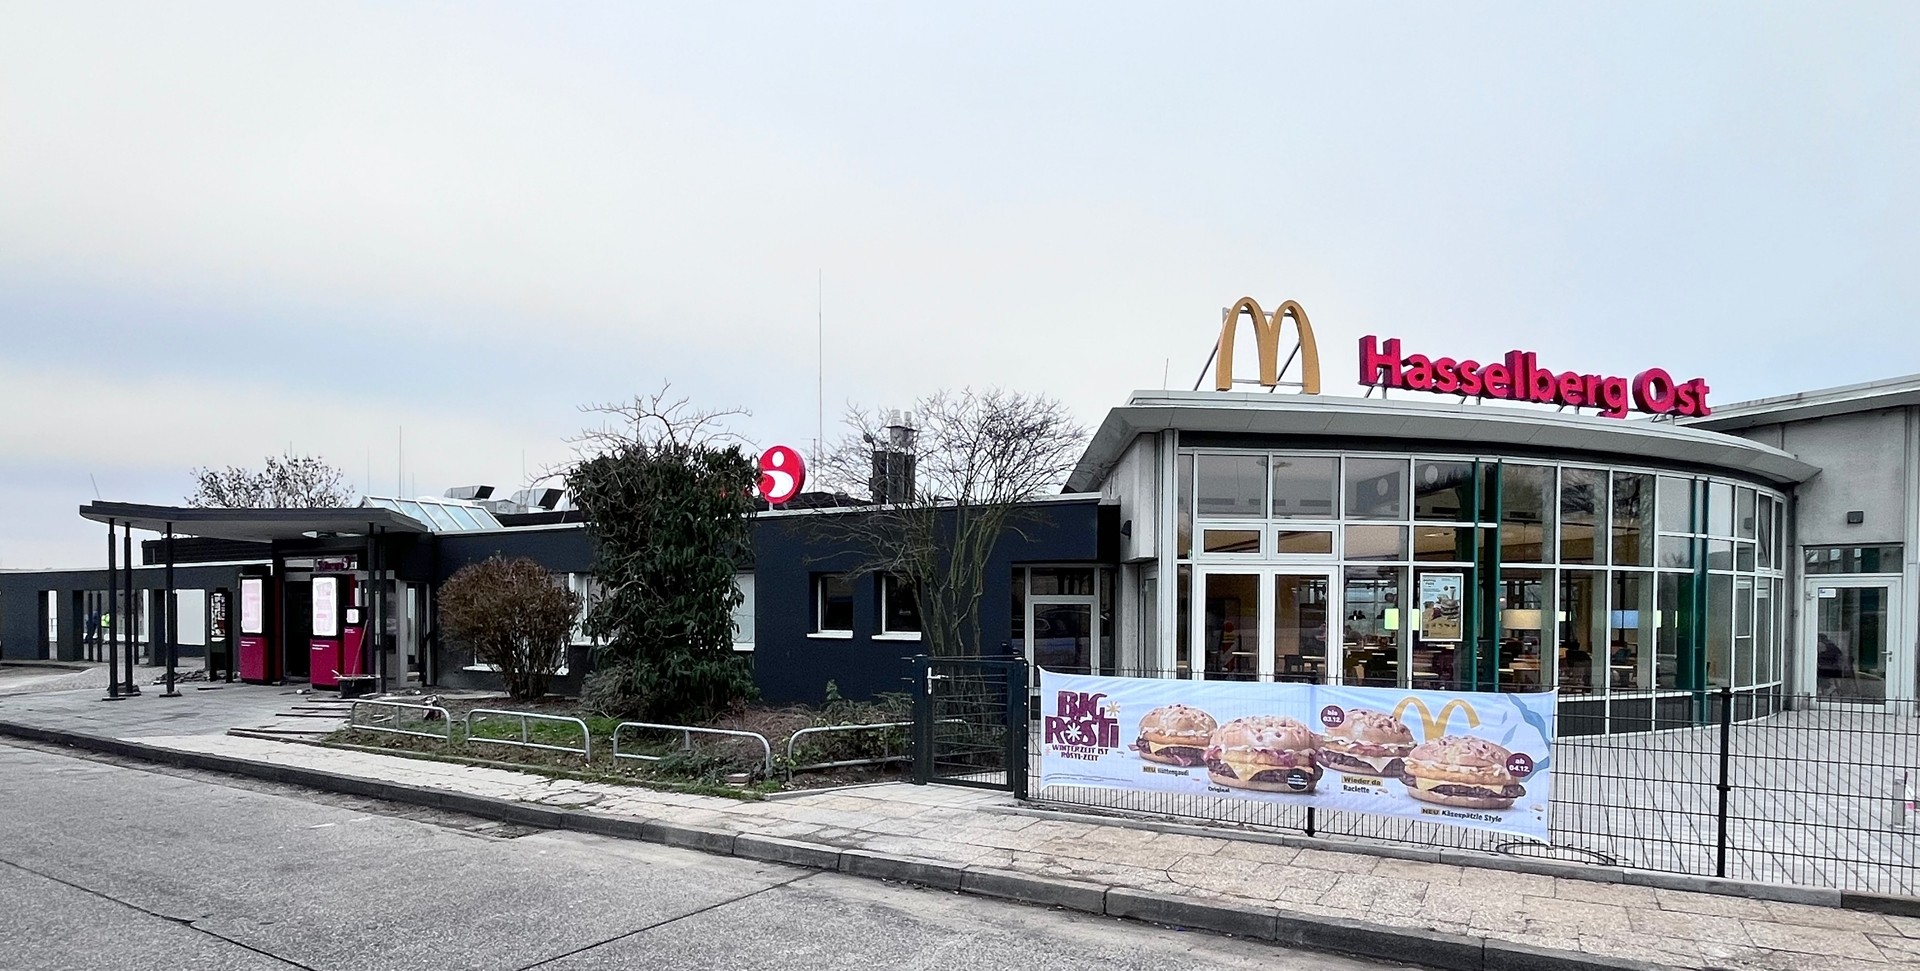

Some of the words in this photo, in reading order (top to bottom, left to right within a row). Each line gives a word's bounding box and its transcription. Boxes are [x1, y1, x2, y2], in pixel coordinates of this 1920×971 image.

[1359, 335, 1627, 419] Hasselberg
[1632, 367, 1711, 417] Ost
[1058, 691, 1107, 719] BIG
[1052, 744, 1096, 754] WINTERZEIT
[1061, 751, 1099, 761] RÖSTI-ZEIT
[1508, 764, 1530, 773] 04.12.
[1343, 775, 1370, 785] Wieder
[1372, 778, 1381, 786] da
[1343, 785, 1370, 794] Raclette
[1442, 810, 1483, 820] Käsespätzle
[1484, 814, 1503, 824] Style
